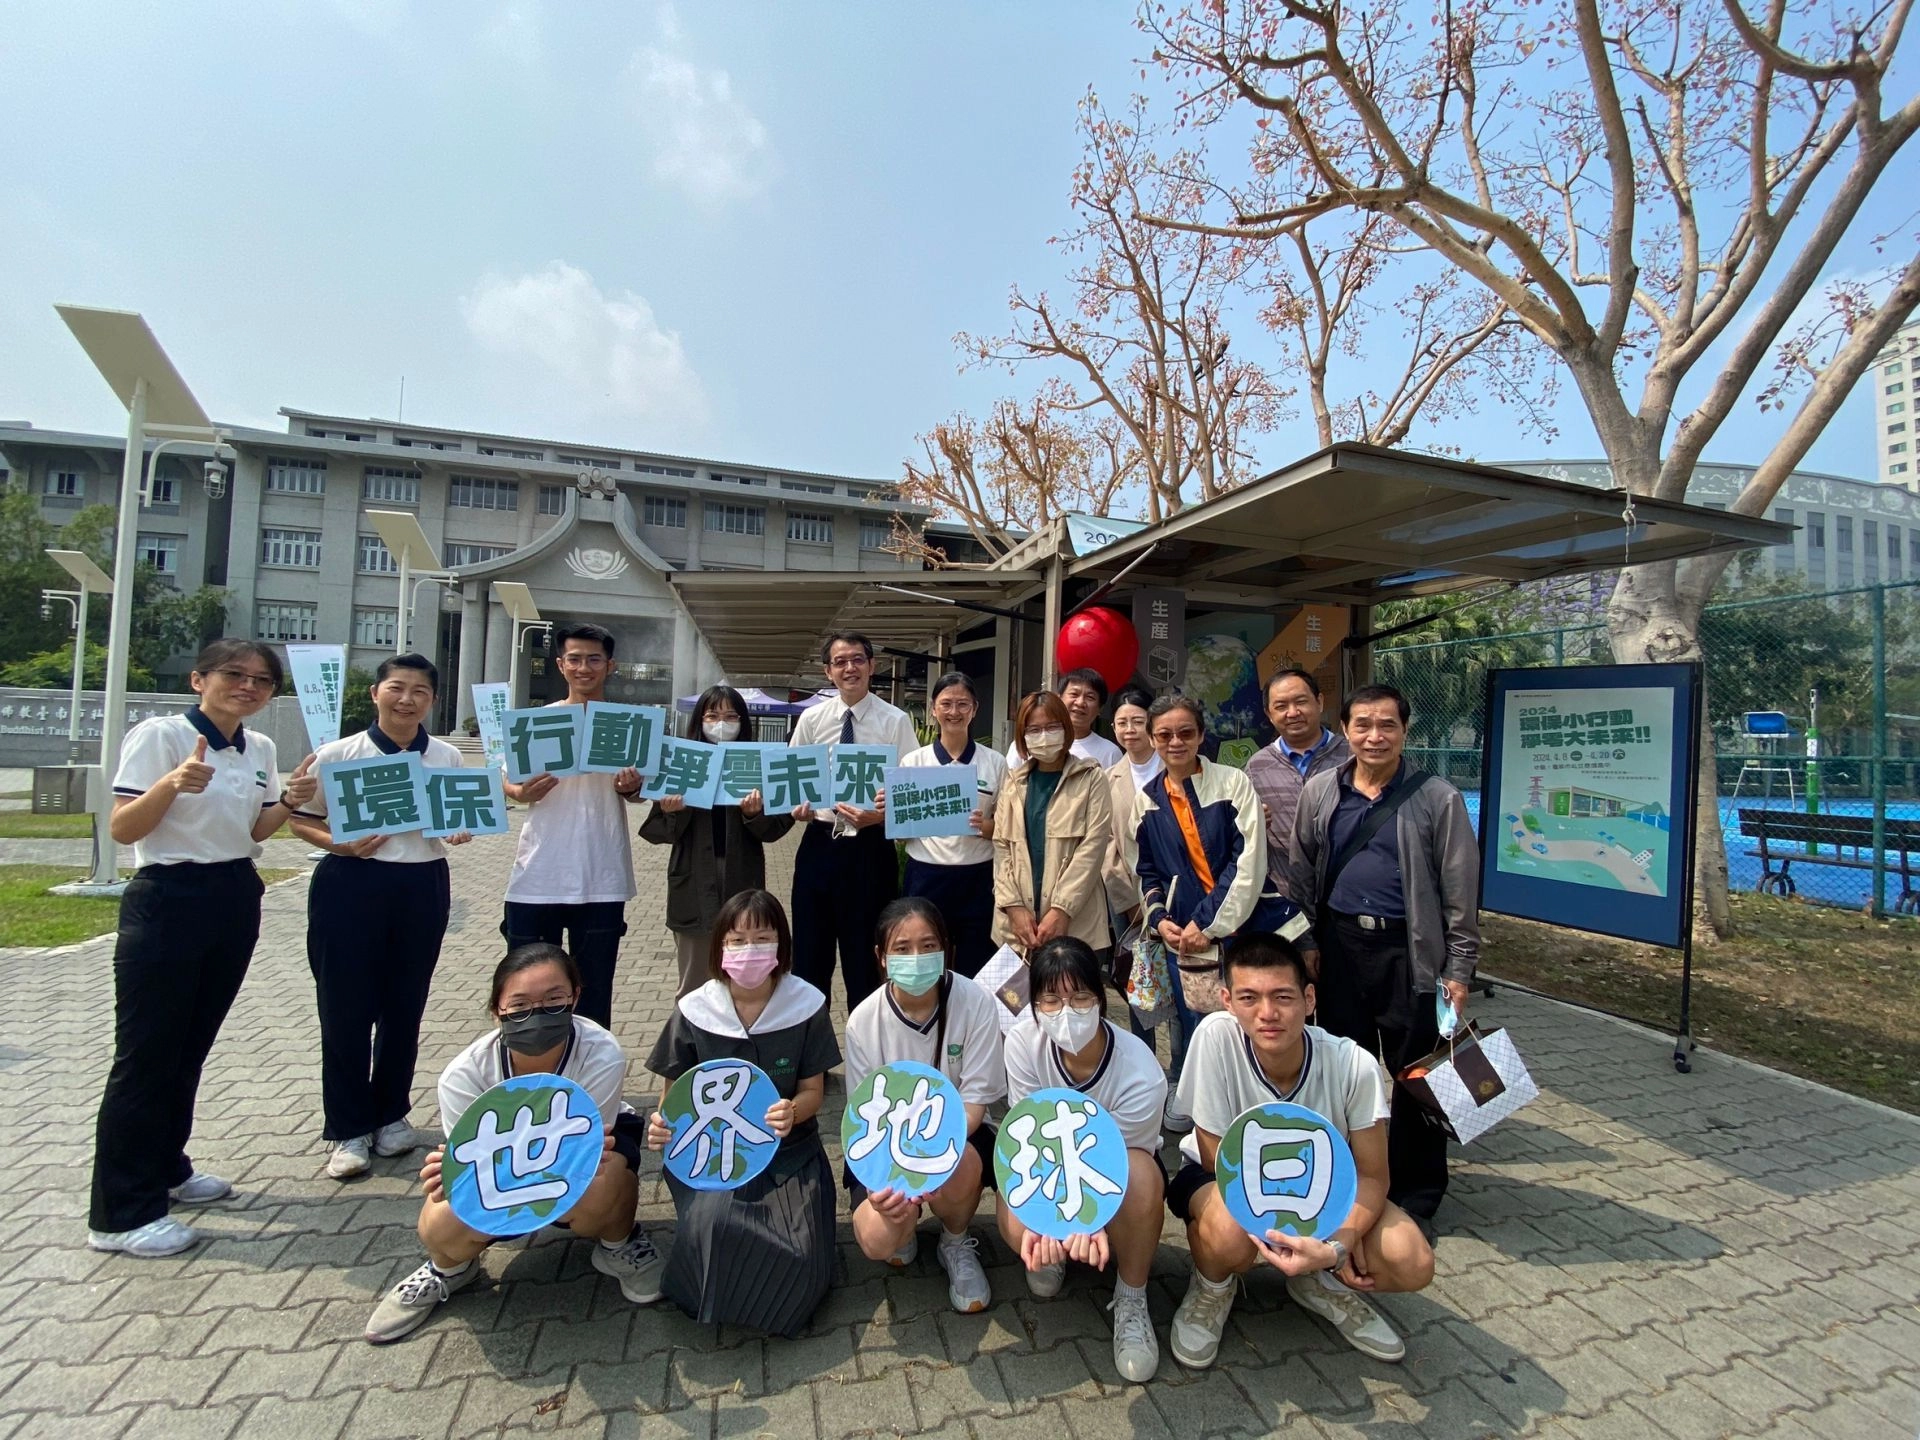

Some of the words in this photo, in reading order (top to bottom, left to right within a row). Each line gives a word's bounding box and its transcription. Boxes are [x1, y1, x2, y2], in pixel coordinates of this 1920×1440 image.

[1305, 615, 1321, 653] 生態
[1, 725, 44, 735] Buddhist
[1519, 706, 1558, 717] 2024
[1519, 709, 1633, 731] 環保小行動
[891, 782, 917, 793] 2024
[892, 783, 961, 807] 環保小行動
[668, 1065, 776, 1182] 界
[847, 1073, 960, 1175] 地
[453, 1090, 592, 1211] 世
[1006, 1099, 1124, 1222] 球
[1241, 1119, 1334, 1222] 日
